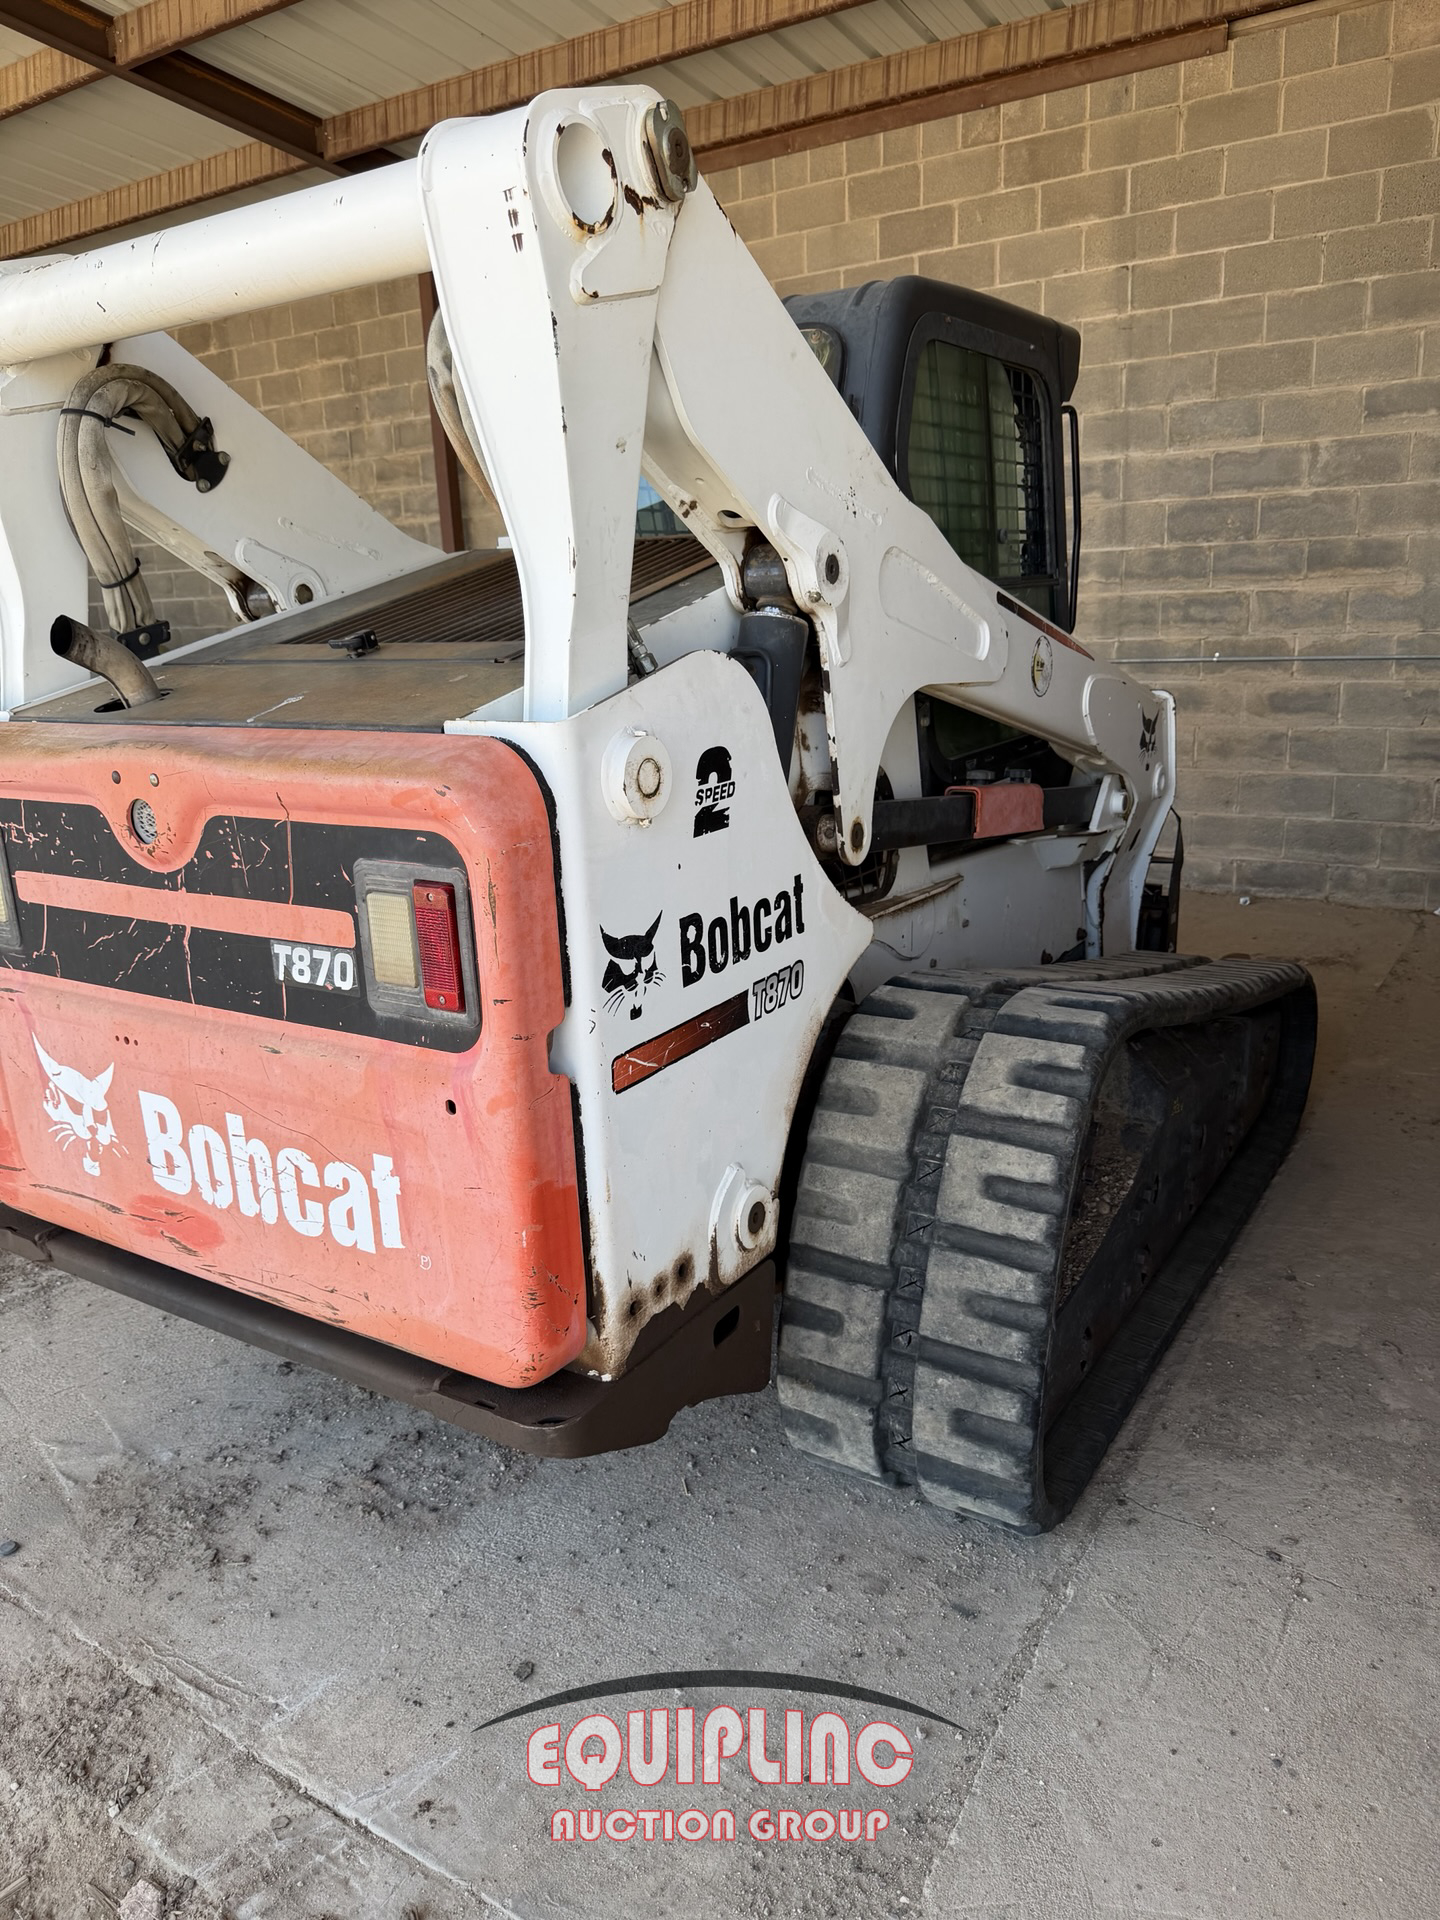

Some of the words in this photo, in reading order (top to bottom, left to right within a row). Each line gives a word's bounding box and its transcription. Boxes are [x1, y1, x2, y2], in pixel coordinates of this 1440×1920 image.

[694, 780, 736, 807] SPEED
[678, 873, 805, 988] Bobcat
[273, 944, 355, 991] T870
[752, 959, 805, 1021] T870
[138, 1089, 406, 1255] Bobcat
